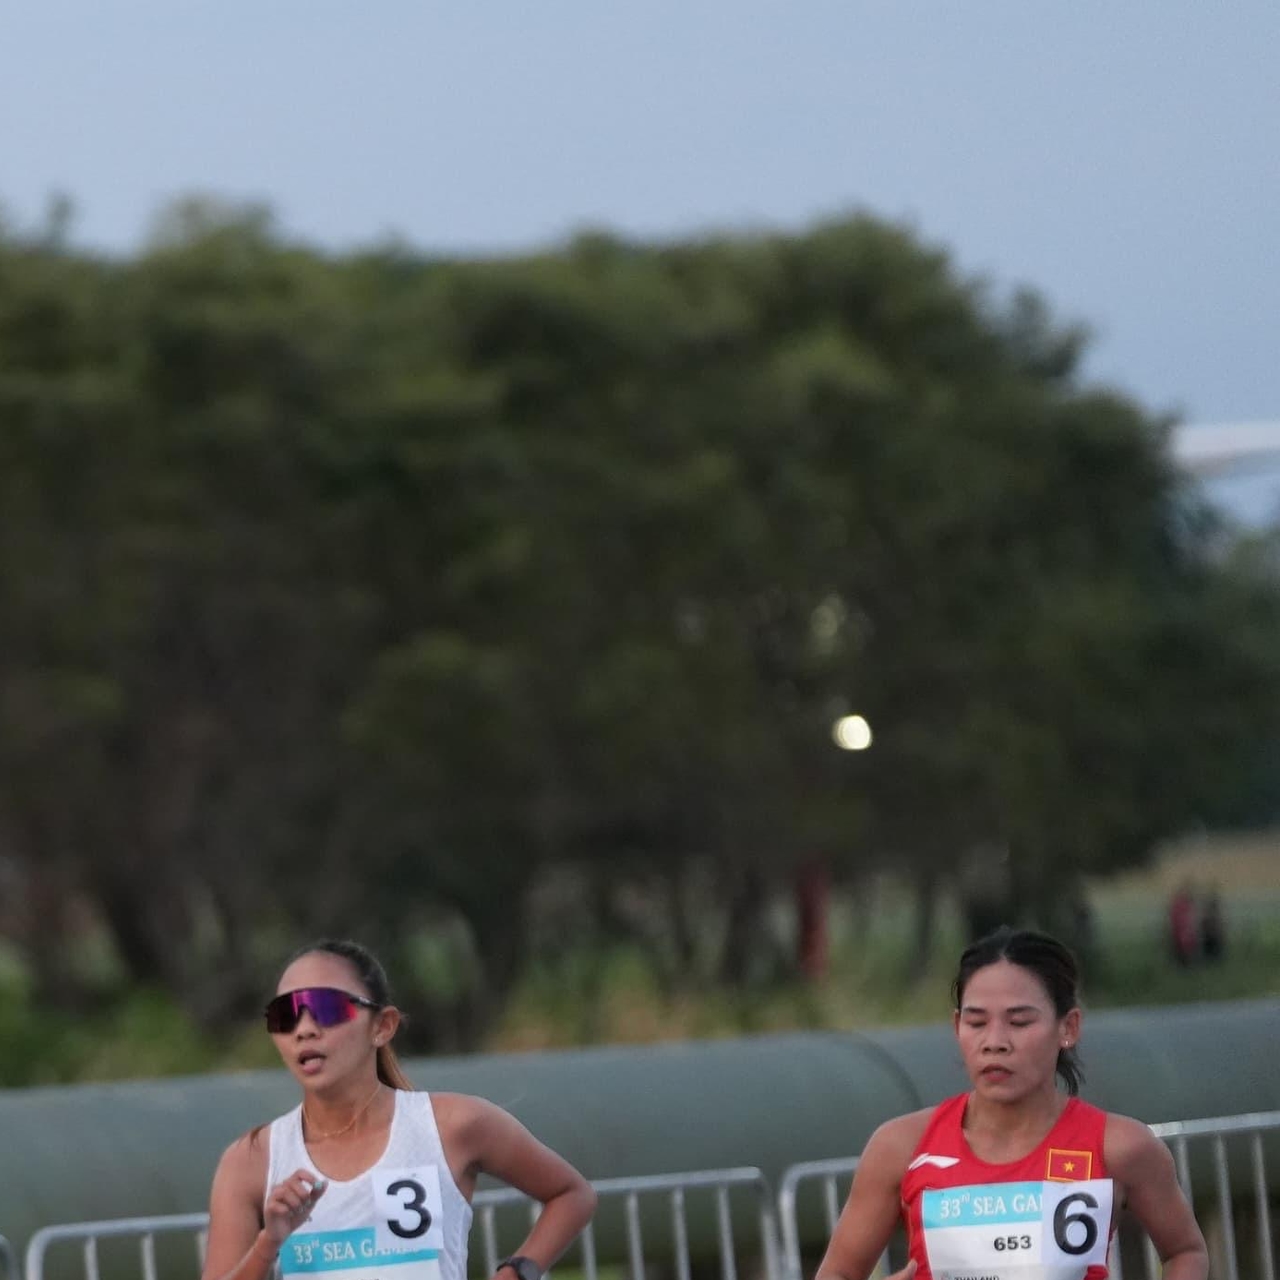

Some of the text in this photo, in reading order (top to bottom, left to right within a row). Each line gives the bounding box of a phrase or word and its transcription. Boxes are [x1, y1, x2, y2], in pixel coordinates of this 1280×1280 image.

[386, 1179, 432, 1239] 3
[974, 1195, 1007, 1216] SEA
[1013, 1193, 1043, 1213] GA
[1053, 1192, 1098, 1256] 6
[323, 1241, 356, 1262] SEA
[993, 1235, 1032, 1251] 653
